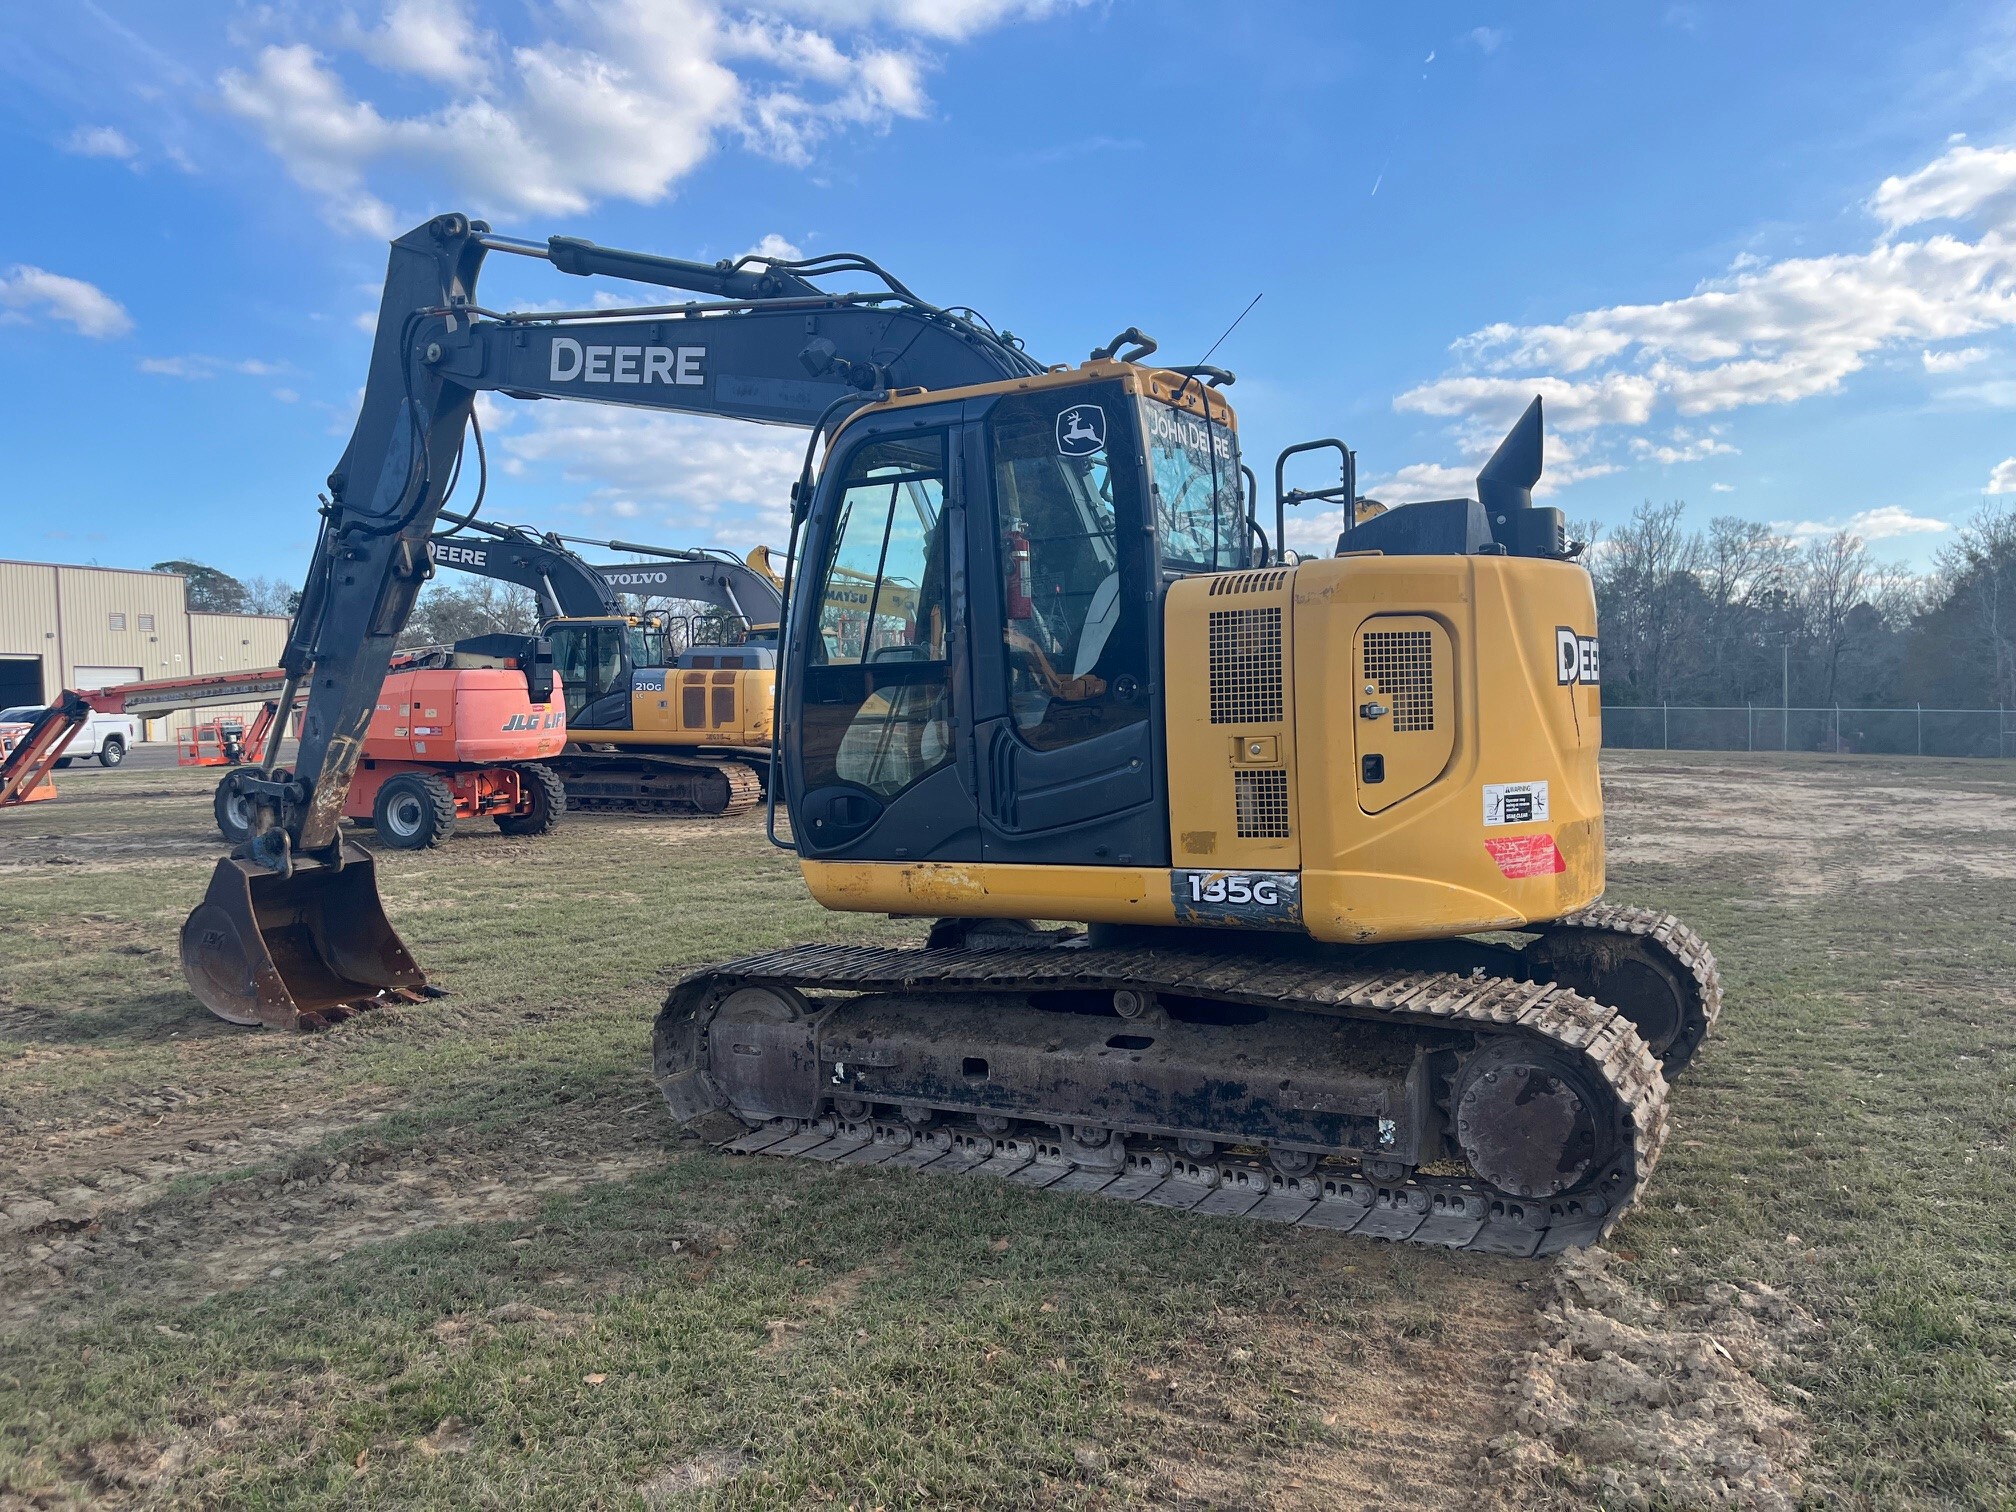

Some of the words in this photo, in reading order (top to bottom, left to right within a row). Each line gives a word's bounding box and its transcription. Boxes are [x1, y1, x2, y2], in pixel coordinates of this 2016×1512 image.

[550, 337, 706, 385] DEERE
[1151, 410, 1187, 446] JOHN
[604, 572, 668, 585] VOLVO
[635, 682, 662, 691] 210G
[501, 714, 540, 731] JLG
[1188, 875, 1278, 905] 135G
